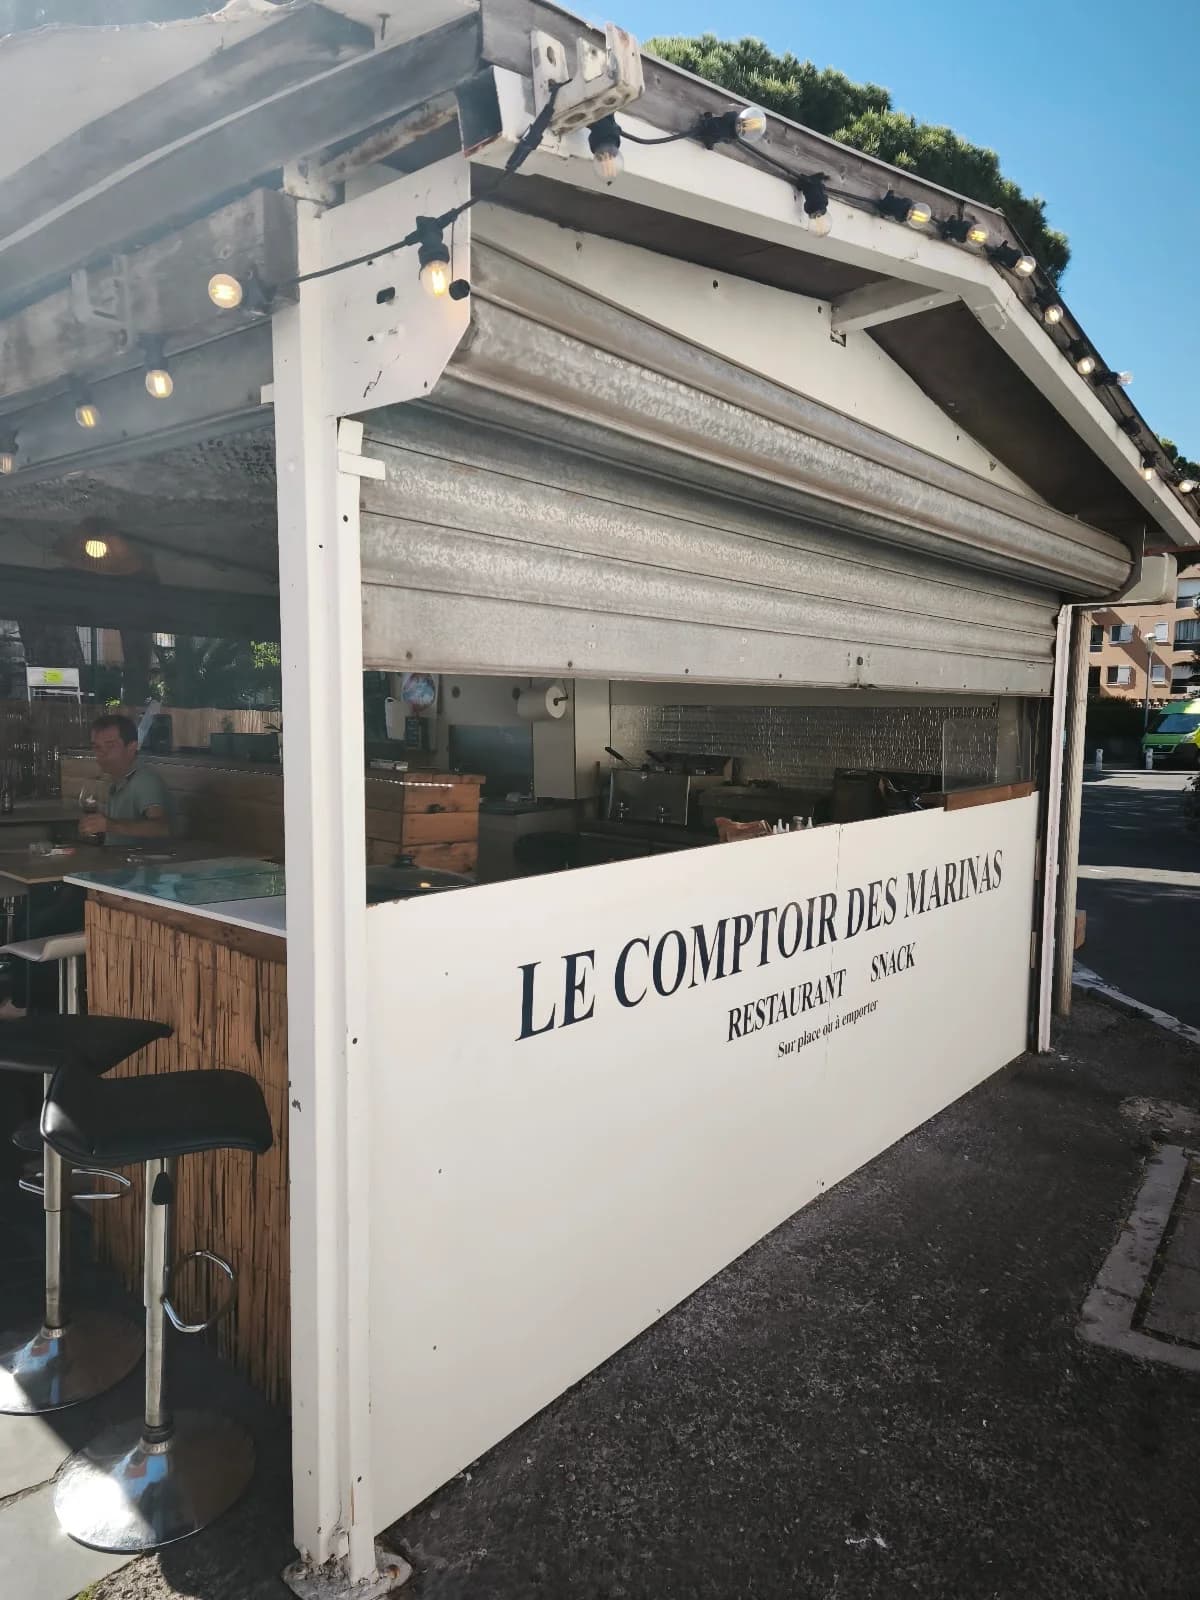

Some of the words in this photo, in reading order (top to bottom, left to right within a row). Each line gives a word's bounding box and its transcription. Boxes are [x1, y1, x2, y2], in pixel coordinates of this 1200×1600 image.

[515, 949, 596, 1042] LE
[614, 893, 839, 1008] COMPTOIR
[844, 876, 898, 940] DES
[903, 849, 1003, 919] MARINAS
[726, 969, 847, 1043] RESTAURANT
[870, 942, 916, 983] SNACK
[777, 1039, 796, 1058] Sur
[797, 1028, 821, 1054] place
[822, 1021, 834, 1037] ou
[835, 1014, 840, 1031] à
[842, 1000, 879, 1027] emporter
